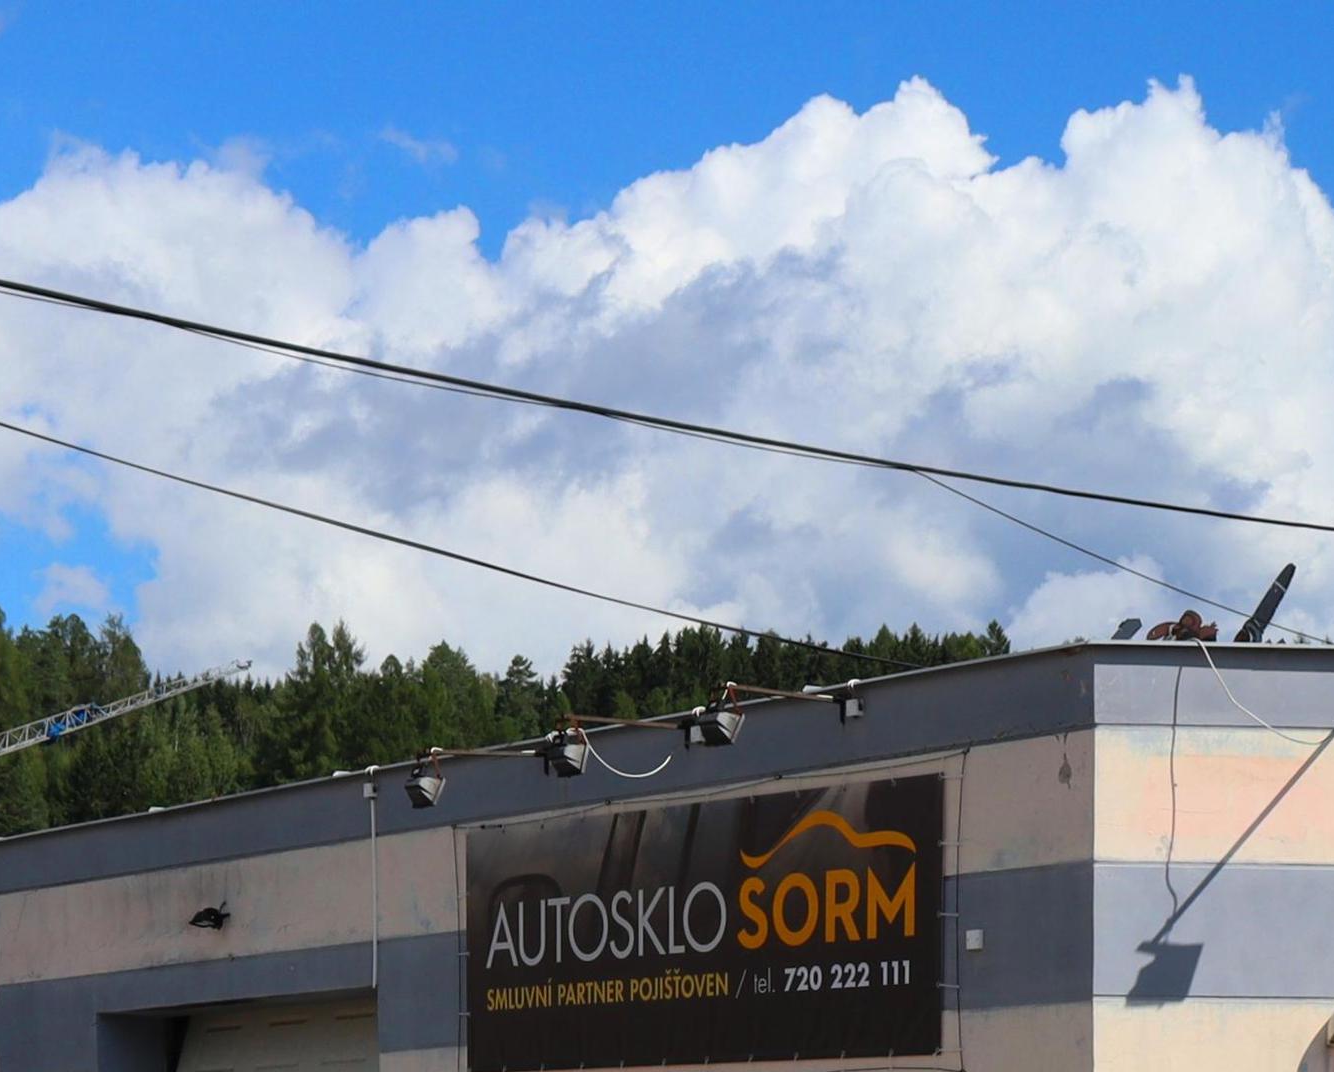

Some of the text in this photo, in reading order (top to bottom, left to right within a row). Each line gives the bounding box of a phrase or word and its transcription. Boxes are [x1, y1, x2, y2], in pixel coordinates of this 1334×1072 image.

[485, 881, 727, 969] AUTOSKLO
[486, 978, 552, 1011] SMLUVNÍ
[558, 980, 624, 1006] PARTNER
[630, 968, 729, 1001] POJIŠŤOVEN
[754, 967, 775, 993] tel.
[784, 965, 822, 992] 720
[830, 962, 870, 989] 222
[880, 960, 910, 986] 111
